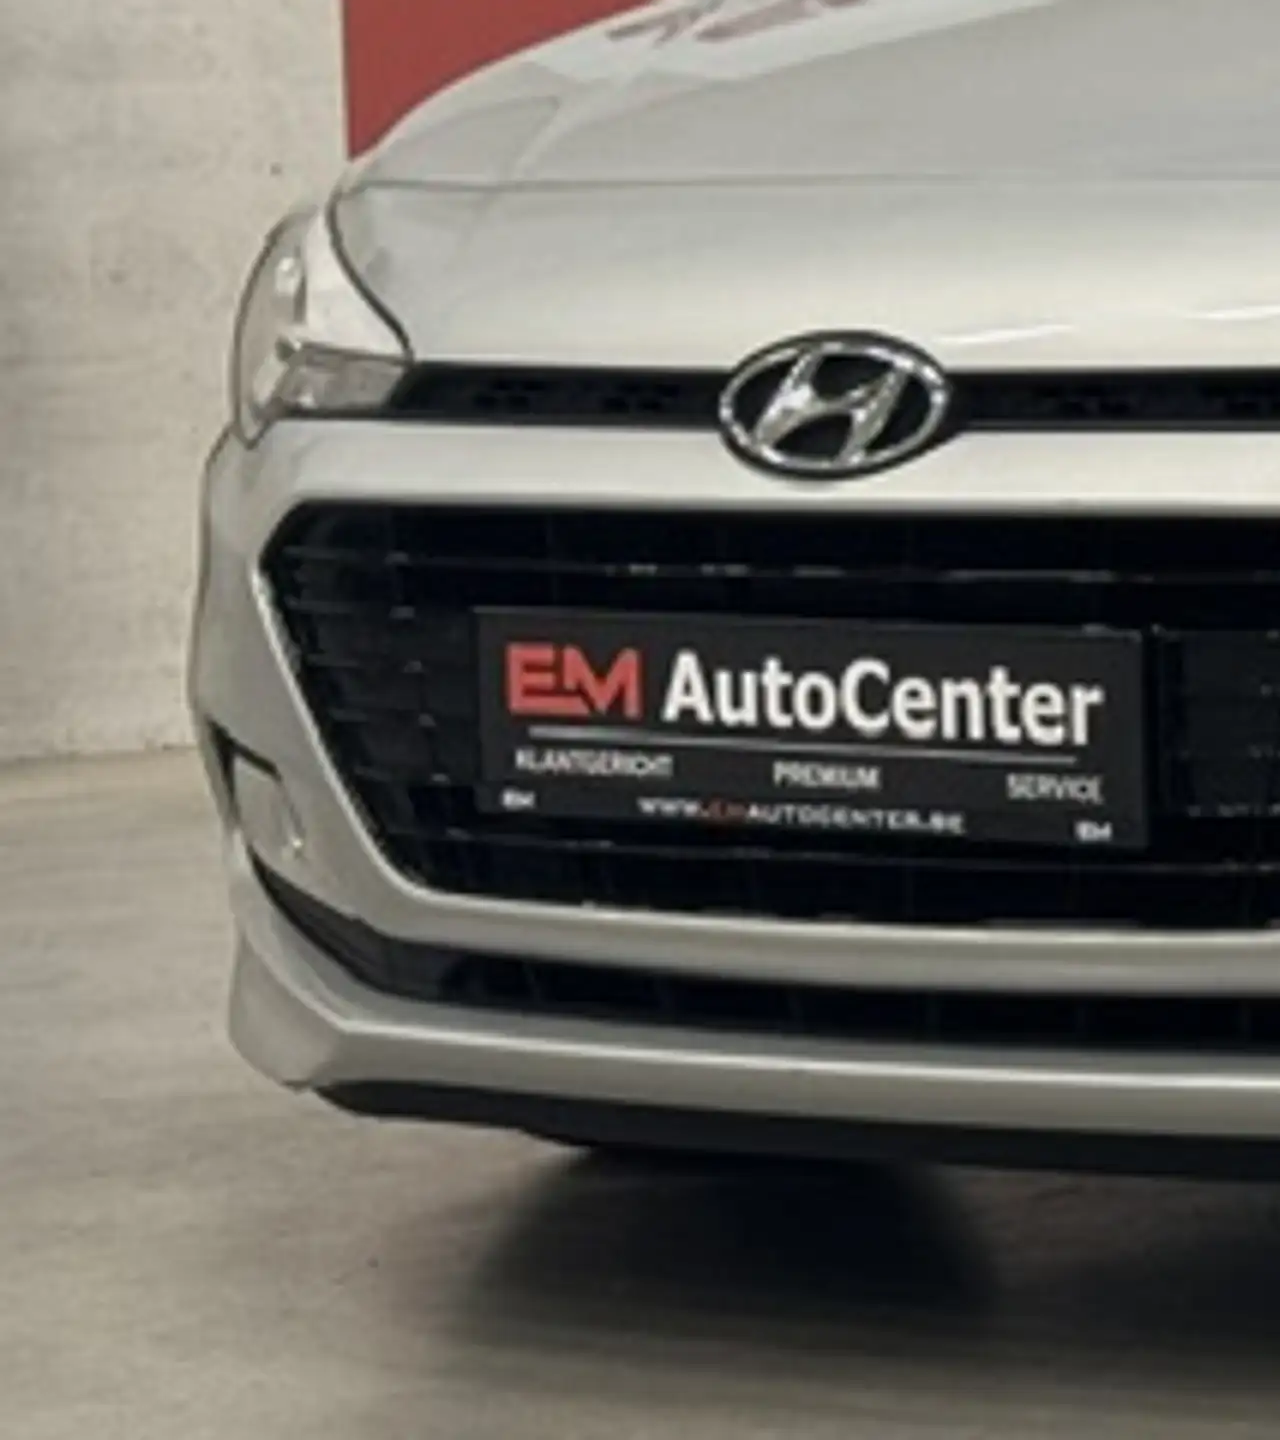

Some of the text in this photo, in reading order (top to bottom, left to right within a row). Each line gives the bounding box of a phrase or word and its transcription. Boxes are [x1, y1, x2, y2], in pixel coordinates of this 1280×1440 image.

[506, 642, 1103, 746] EM AutoCenter
[772, 760, 882, 791] PREMIUM
[1006, 771, 1104, 805] SERVICE
